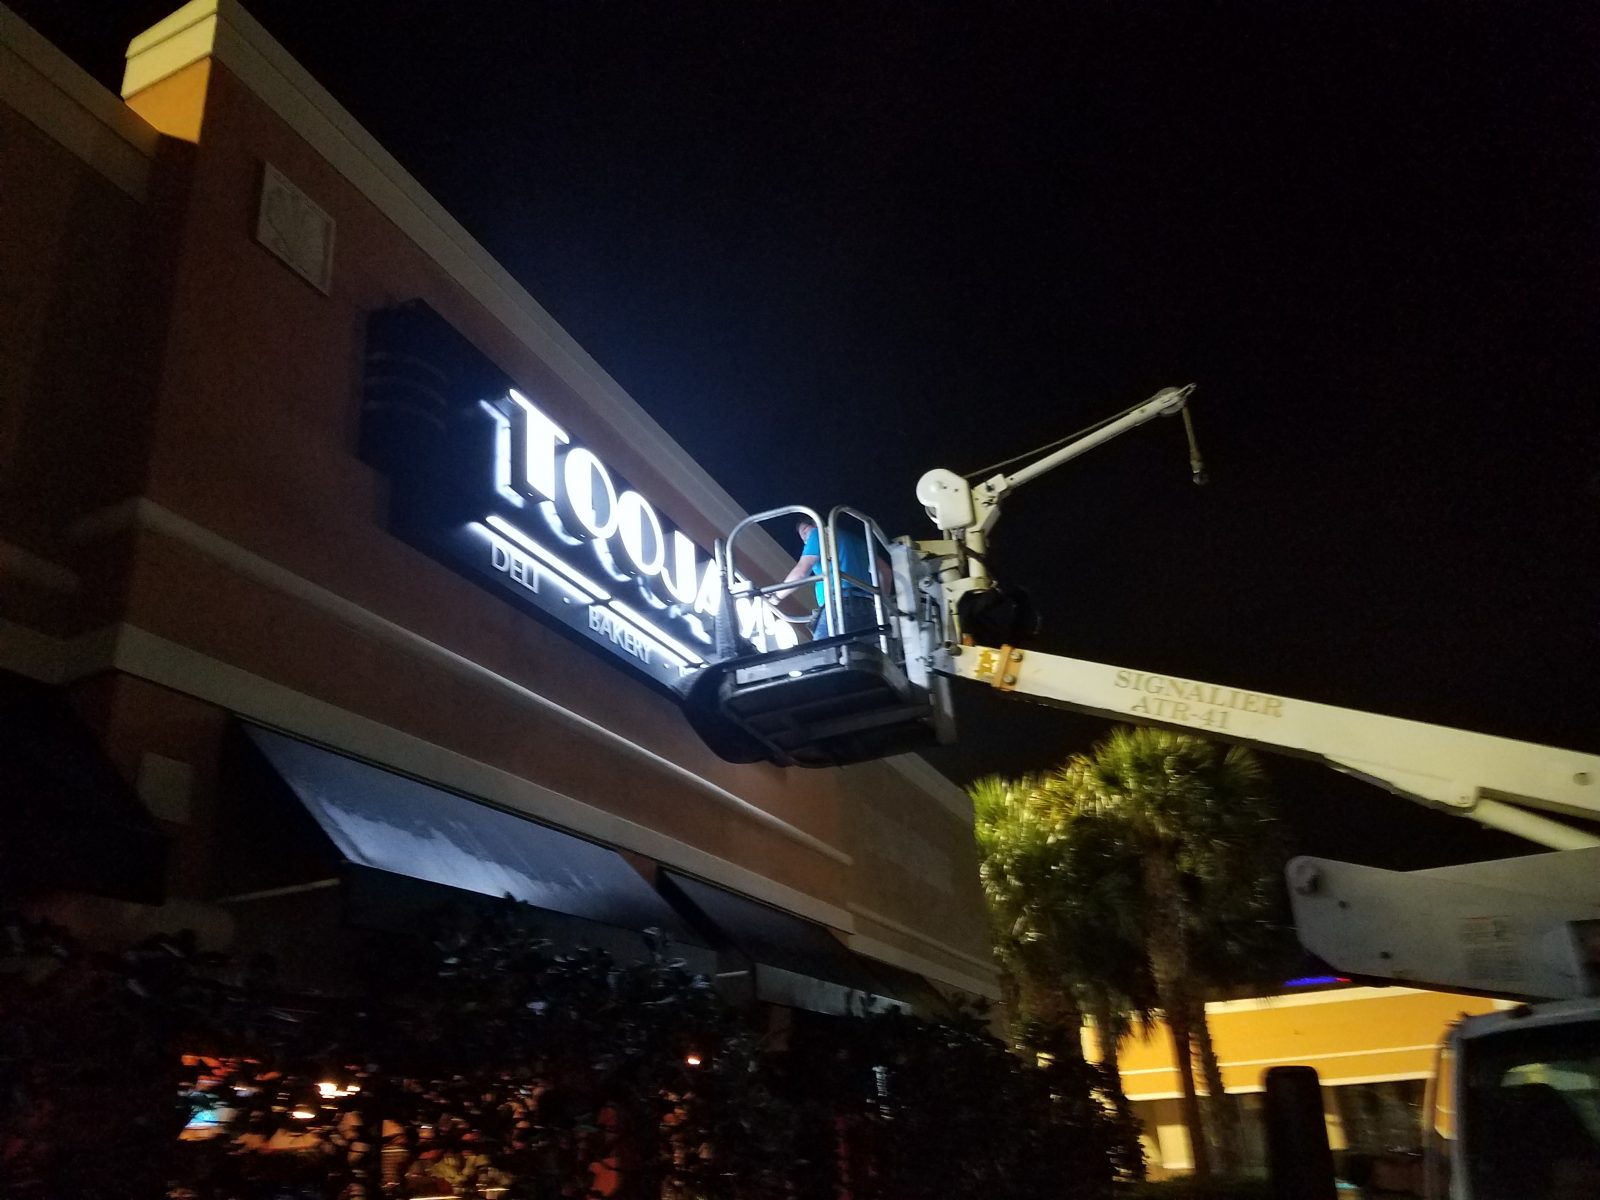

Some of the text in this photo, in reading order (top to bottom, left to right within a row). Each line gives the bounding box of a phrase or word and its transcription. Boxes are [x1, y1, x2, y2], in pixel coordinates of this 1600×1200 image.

[509, 388, 798, 650] TOOJA
[491, 542, 652, 665] DELI BAKERY
[1114, 670, 1283, 718] SIGNALIER
[1131, 695, 1230, 729] ATR-41
